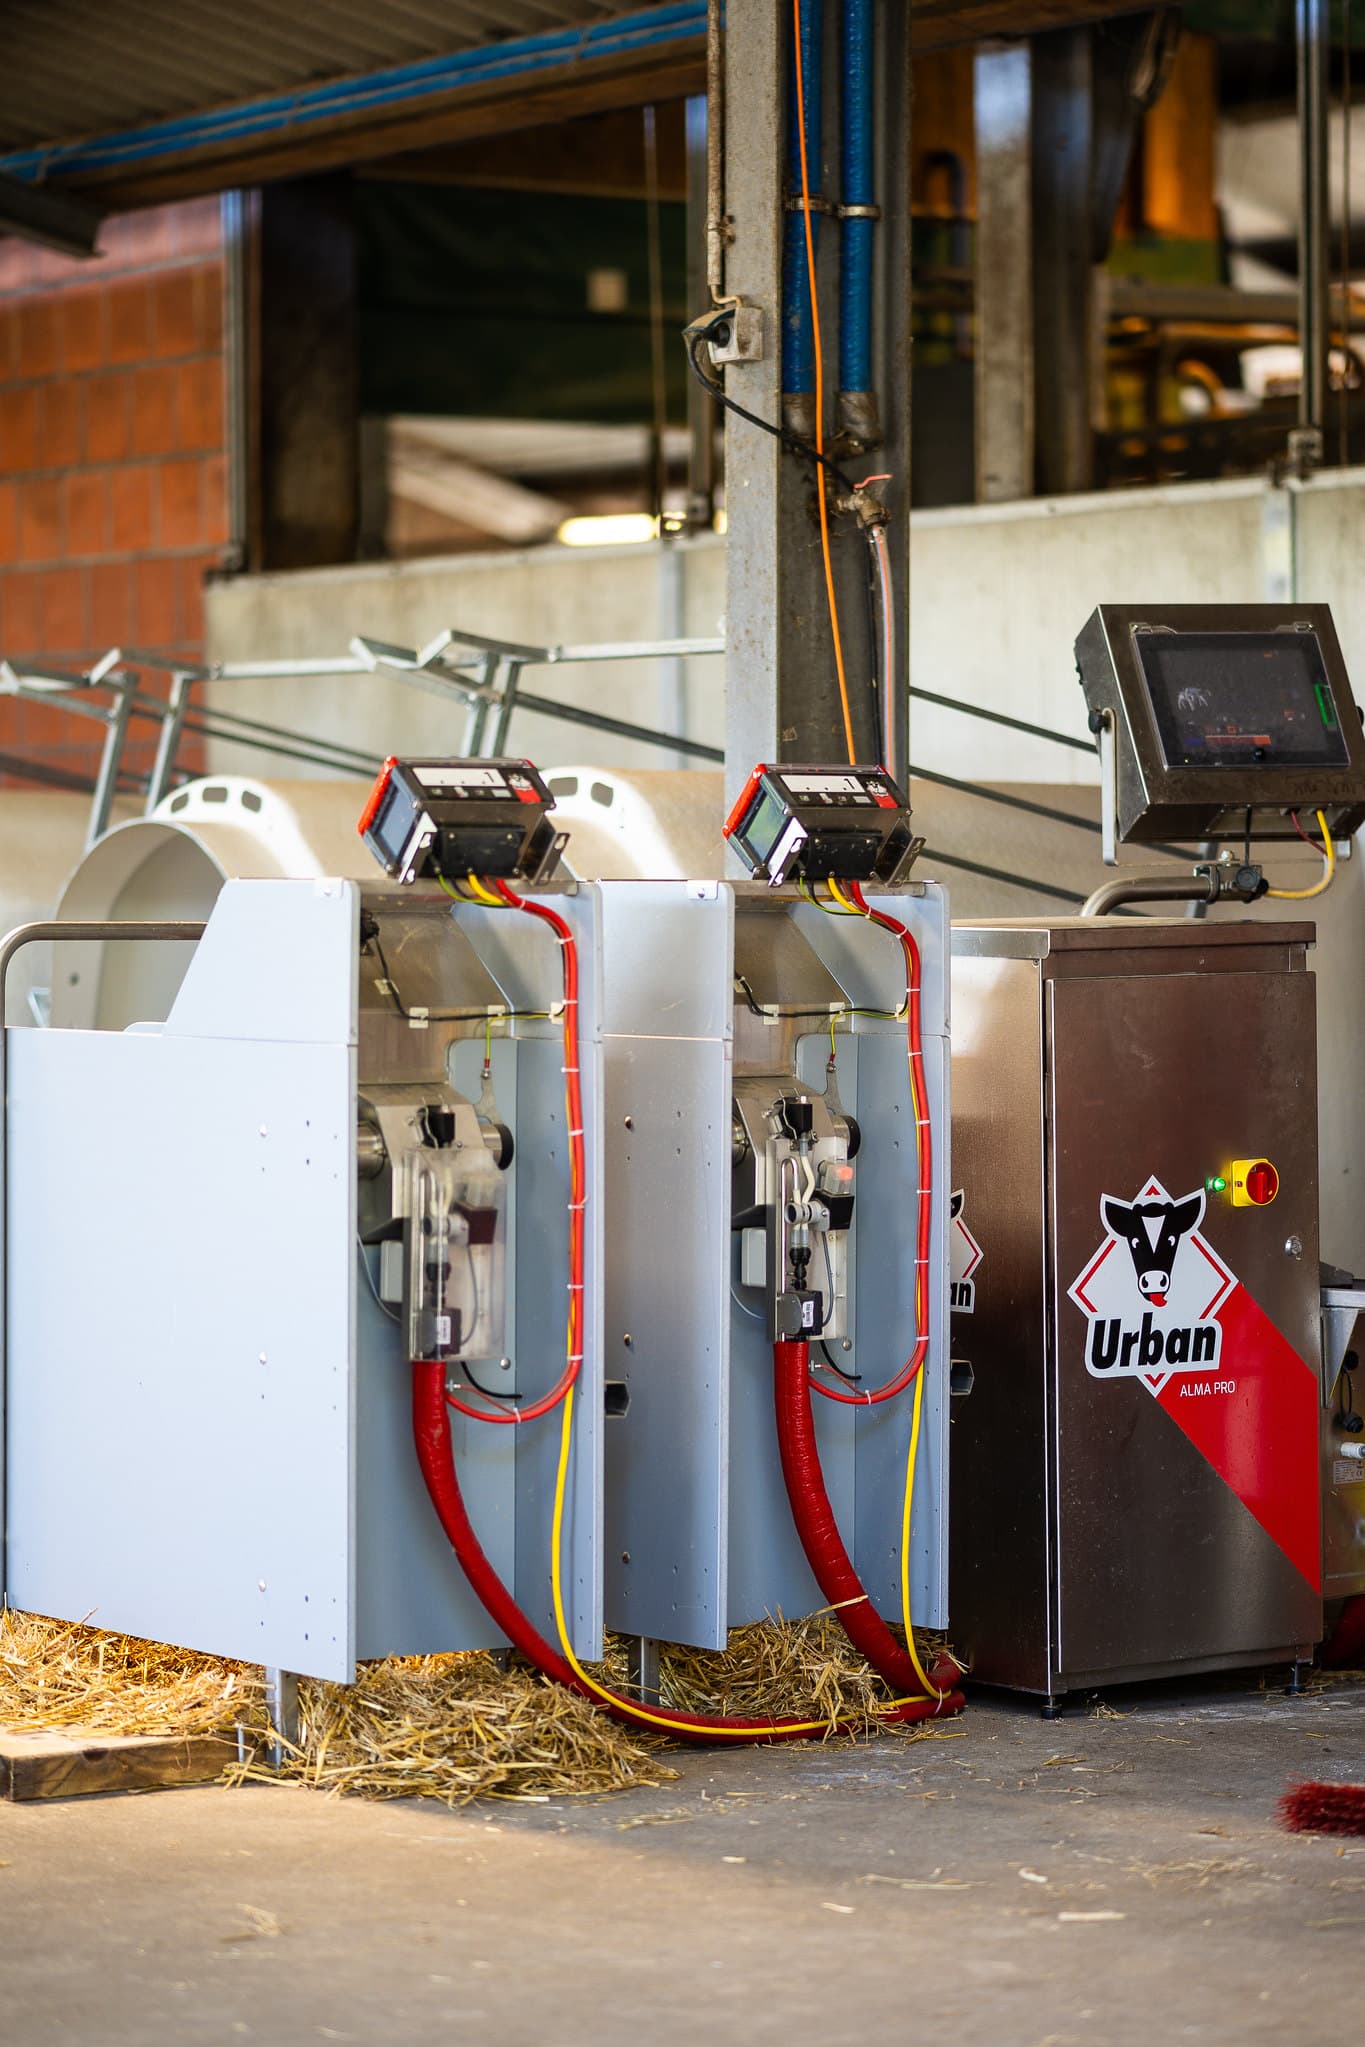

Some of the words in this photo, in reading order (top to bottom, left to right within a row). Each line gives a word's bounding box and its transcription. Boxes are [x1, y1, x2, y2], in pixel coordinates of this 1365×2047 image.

[1091, 1312, 1217, 1370] Urban
[1180, 1382, 1212, 1397] ALMA
[1213, 1381, 1236, 1395] PRO
